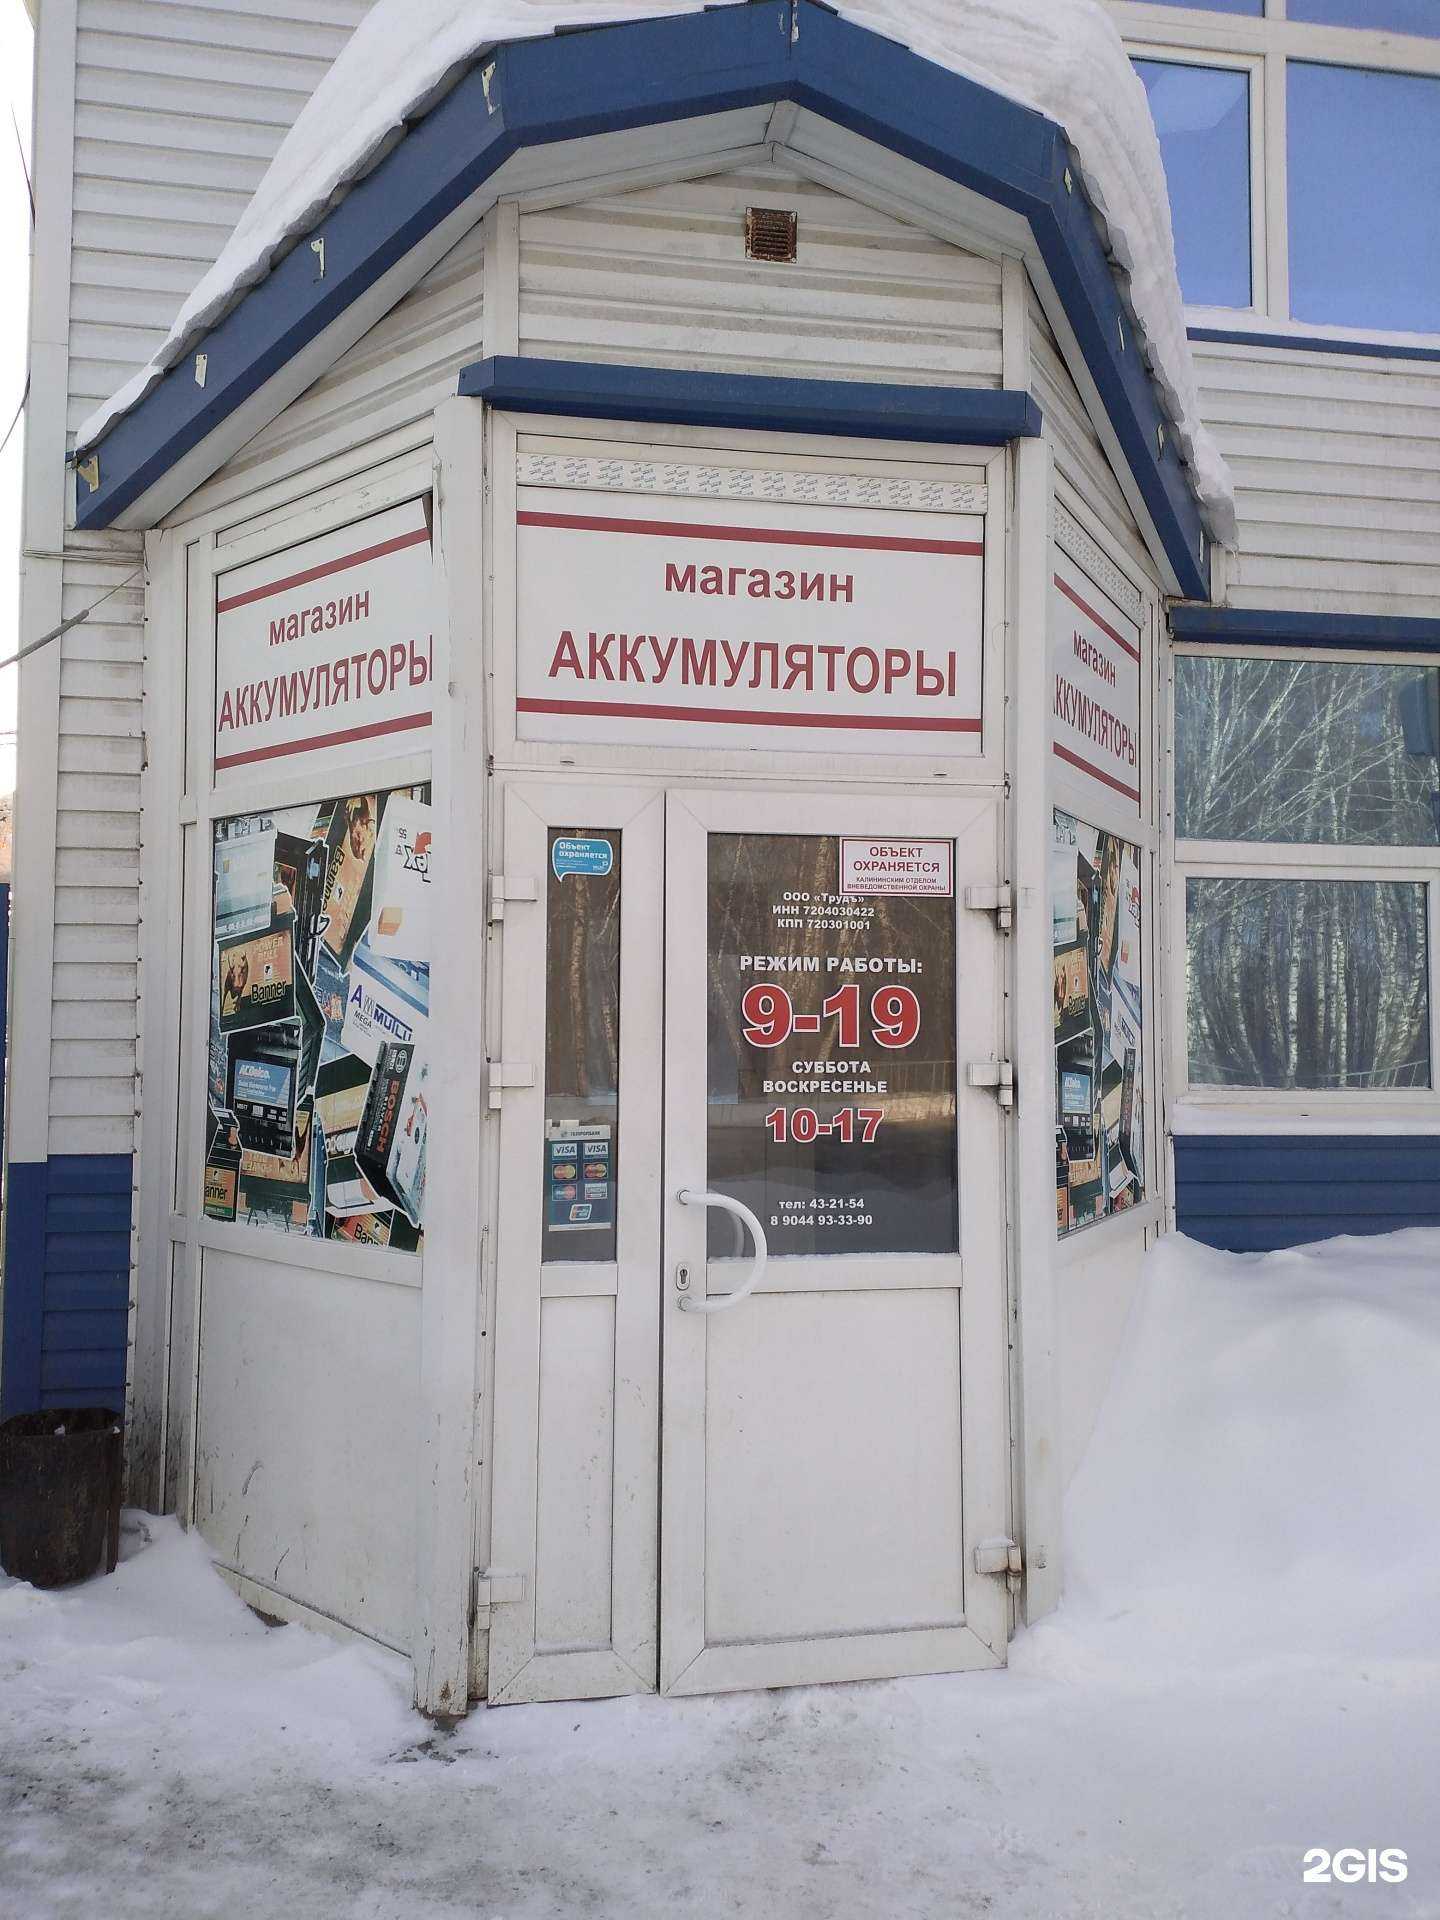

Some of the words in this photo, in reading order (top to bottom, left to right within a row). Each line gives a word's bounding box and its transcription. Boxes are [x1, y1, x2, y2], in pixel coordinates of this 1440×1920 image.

[665, 562, 854, 603] магазин
[269, 590, 370, 646] магазин
[548, 630, 957, 697] АККУМУЛЯТОРЫ
[1073, 629, 1117, 688] магазин
[218, 634, 433, 732] АККУМУЛЯТОРЫ
[1053, 673, 1137, 768] ККУМУЛЯТОРЫ
[869, 846, 923, 858] ОБЪЕКТ
[853, 860, 940, 873] ОХРАНЯЕТСЯ
[322, 847, 346, 914] Banne
[847, 883, 918, 891] ВНЕВЕДОМСТВЕННОЙ
[783, 891, 810, 902] ООО
[814, 892, 865, 904] «Трудъ»
[772, 905, 800, 915] ИНН
[803, 905, 875, 917] 7204030422
[777, 918, 803, 928] КПП
[806, 919, 870, 930] 720301001
[740, 955, 820, 972] РЕЖИМ
[826, 957, 923, 974] РАБОТЫ:
[251, 980, 287, 1003] Banner
[354, 1010, 372, 1028] MEGA
[741, 983, 921, 1049] 9-19
[792, 1061, 871, 1073] СУББОТА
[763, 1080, 887, 1093] ВОСКРЕСЕНЬЕ
[376, 1079, 401, 1153] BOSCH
[765, 1107, 885, 1143] 10-17
[556, 1146, 576, 1154] VISA
[588, 1144, 607, 1153] VISA
[206, 1184, 228, 1201] anner
[779, 1200, 805, 1209] тел:
[809, 1198, 865, 1209] 43-21-54
[770, 1215, 778, 1226] 8
[782, 1215, 814, 1226] 9044
[817, 1214, 873, 1226] 93-33-90
